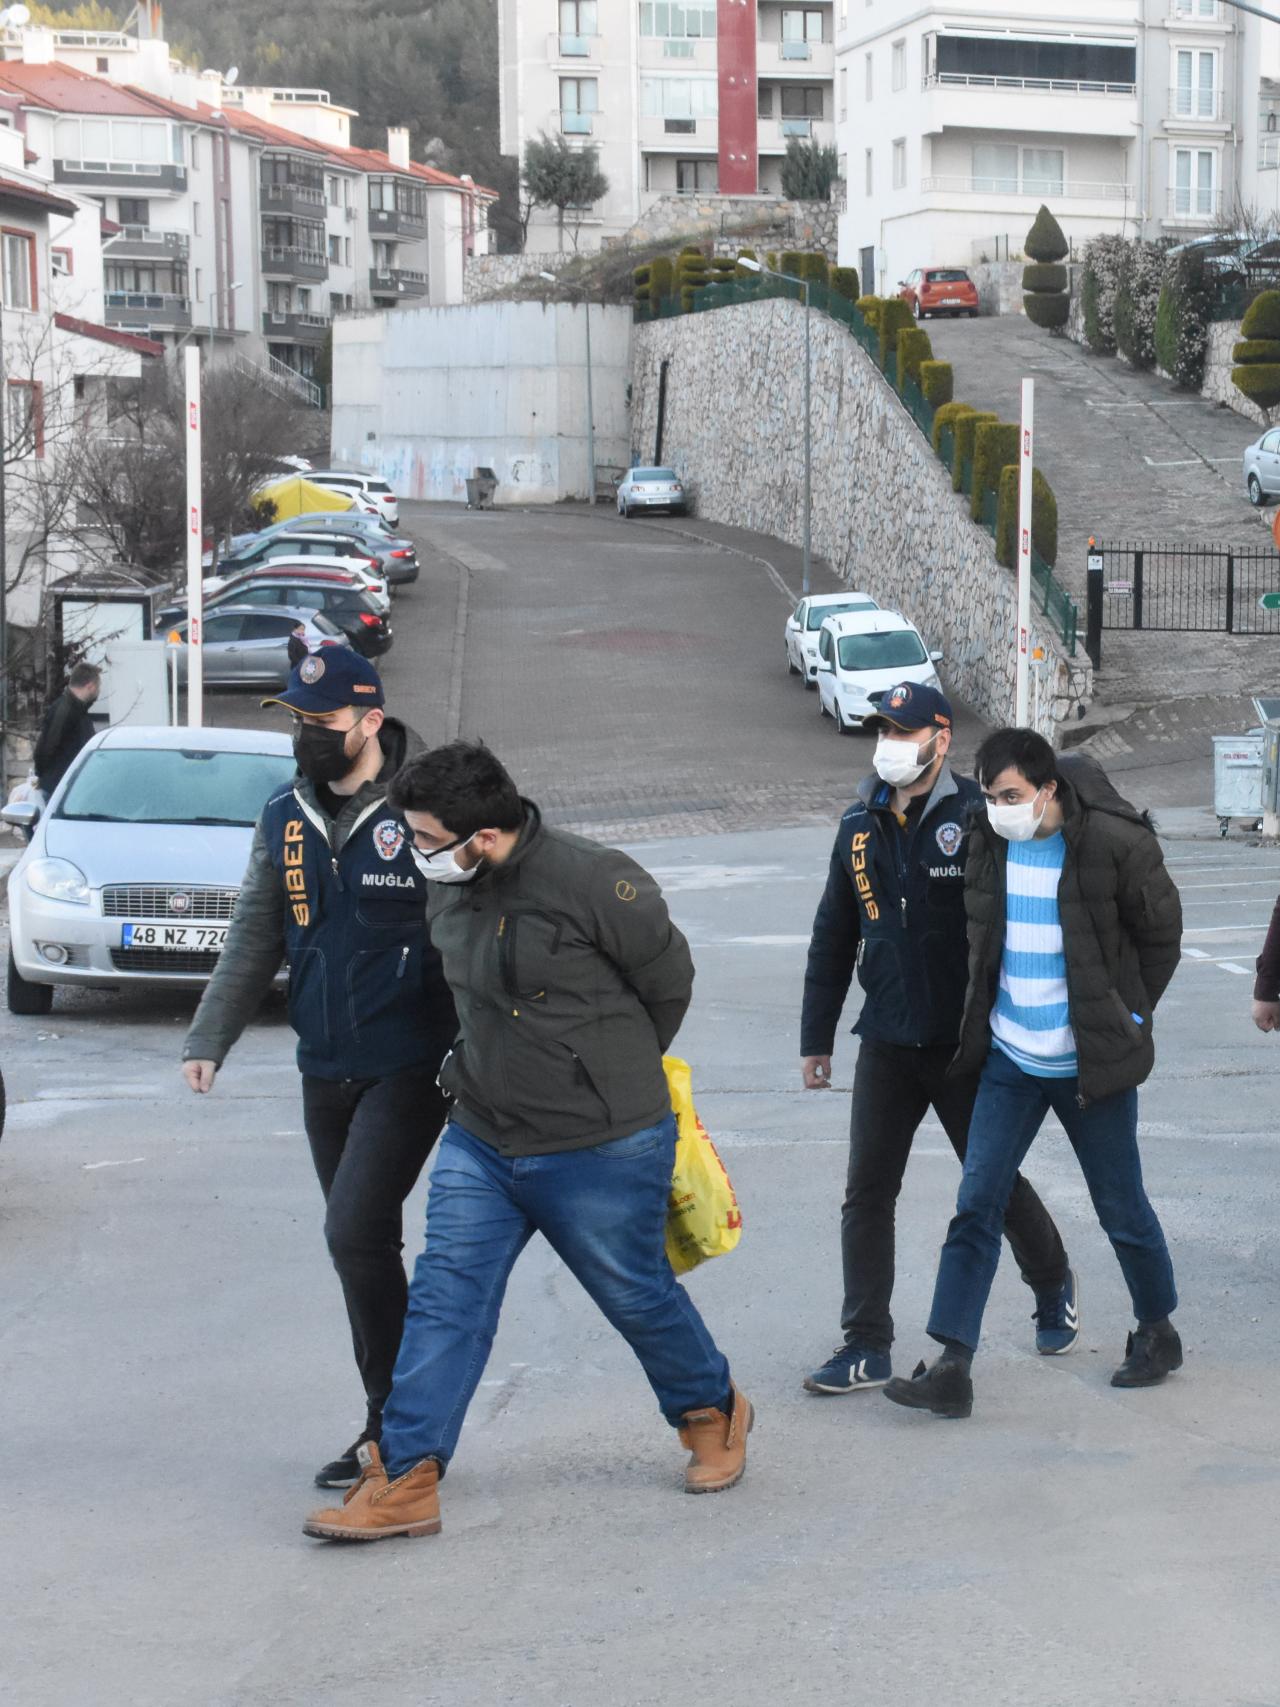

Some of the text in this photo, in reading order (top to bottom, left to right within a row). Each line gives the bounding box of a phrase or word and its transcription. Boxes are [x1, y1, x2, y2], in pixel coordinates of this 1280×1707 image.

[929, 864, 965, 878] MUĞL
[362, 872, 415, 888] MUĞLA
[133, 927, 156, 944] 48
[164, 928, 187, 945] NZ
